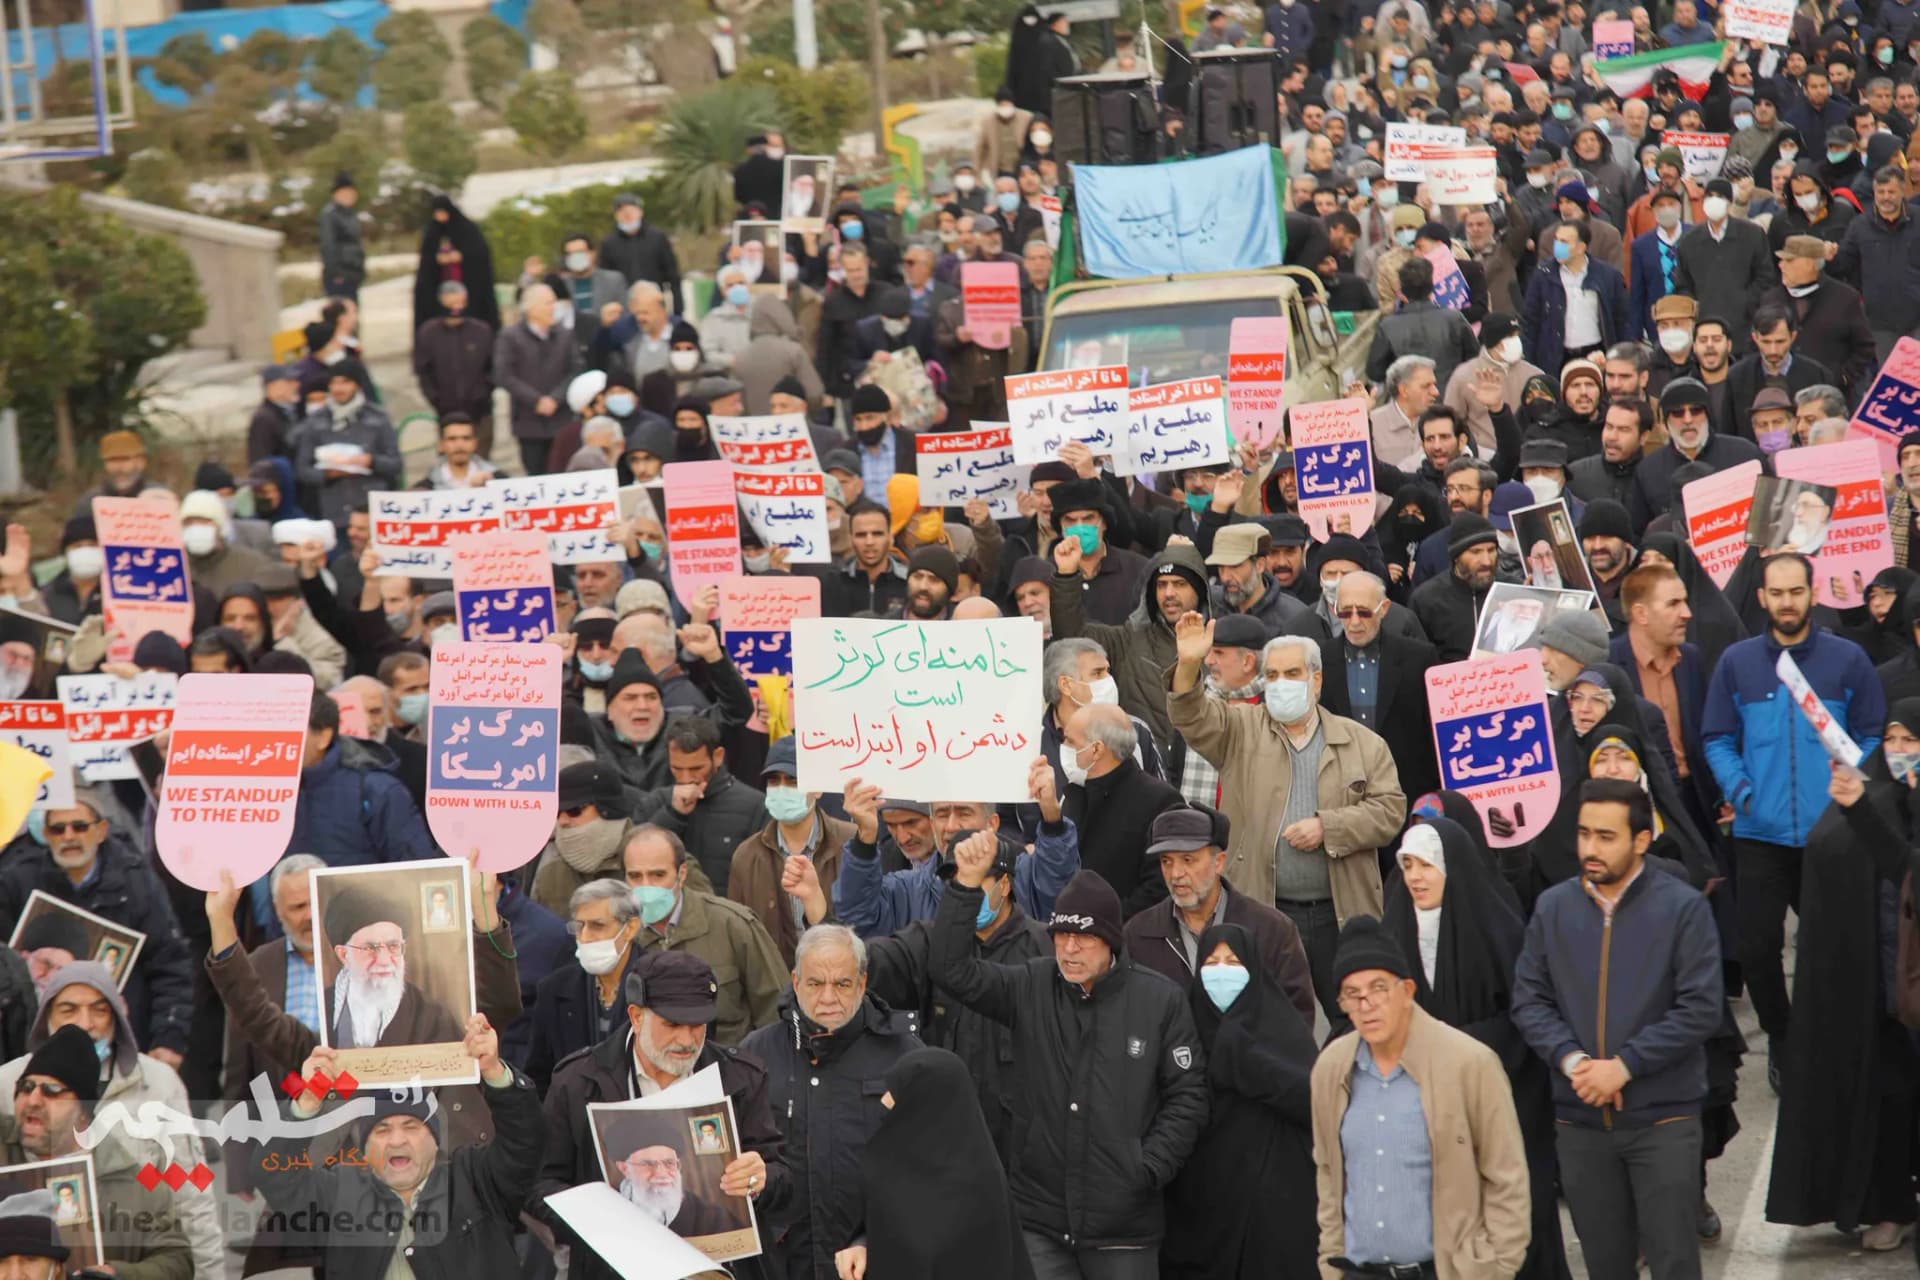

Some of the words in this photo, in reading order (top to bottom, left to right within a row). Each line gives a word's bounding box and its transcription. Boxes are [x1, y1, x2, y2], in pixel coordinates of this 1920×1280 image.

[1032, 374, 1073, 391] ایستاده
[1076, 369, 1098, 389] آخر
[1100, 370, 1109, 383] تا
[1110, 370, 1122, 383] ما
[1013, 382, 1031, 397] ایم
[1168, 382, 1190, 403] آخر
[1193, 383, 1202, 396] تا
[1203, 382, 1215, 394] ما
[1876, 385, 1899, 402] بر
[1025, 400, 1053, 428] امر
[1060, 394, 1119, 423] مطیع
[1232, 402, 1243, 411] TO
[1244, 402, 1258, 411] THE
[1260, 401, 1277, 410] END
[1154, 406, 1212, 436] مطیع
[923, 437, 940, 452] ایم
[942, 435, 981, 450] ایستاده
[984, 429, 1006, 449] آخر
[1140, 439, 1210, 466] رهبریم
[1303, 451, 1318, 472] بر
[1321, 444, 1361, 467] مرگ
[934, 456, 961, 479] امر
[967, 450, 1015, 477] طیع
[774, 476, 794, 496] آخر
[806, 477, 818, 491] ما
[1302, 468, 1365, 494] امریکا
[379, 498, 431, 520] آمریکا
[439, 505, 451, 519] بر
[459, 498, 494, 516] مرگ
[764, 501, 814, 527] مطیع
[377, 523, 439, 546] اسرائیل
[1827, 523, 1886, 541] TANDUP
[1717, 540, 1747, 557] STAN
[1851, 539, 1881, 553] END
[112, 551, 131, 572] بر
[132, 548, 178, 573] مرگ
[678, 564, 691, 575] TO
[693, 563, 710, 573] THE
[713, 561, 734, 572] END
[112, 573, 184, 601] امریکا
[468, 596, 489, 619] بر
[493, 590, 544, 616] مرگ
[468, 618, 549, 643] امریکا
[734, 637, 754, 658] بر
[804, 623, 908, 692] کوثر
[478, 653, 499, 668] مرگ
[502, 654, 523, 669] شعار
[524, 657, 547, 669] همین
[452, 671, 486, 685] اسرائیل
[499, 671, 520, 685] مرگ
[521, 675, 528, 685] و
[439, 686, 461, 701] آورد
[463, 690, 478, 701] می
[480, 688, 504, 701] مرگ
[504, 687, 520, 700] آنها
[522, 691, 544, 704] برای
[894, 680, 963, 707] است
[26, 706, 40, 723] تا
[41, 706, 58, 723] ما
[69, 712, 129, 740] اسرائیل
[443, 715, 471, 745] بر
[478, 709, 545, 747] مرگ
[802, 712, 861, 753] است
[1477, 711, 1536, 742] مرگ
[898, 719, 937, 770] او
[946, 712, 1028, 761] دشمن
[1449, 725, 1472, 753] بر
[171, 743, 196, 765] ایم
[197, 743, 250, 765] ایستاده
[250, 742, 285, 766] آخر
[285, 743, 299, 761] تا
[1449, 740, 1543, 781] امریکا
[440, 751, 546, 790] امریکا
[167, 787, 198, 802] WE
[201, 788, 294, 803] STANDUP
[1486, 785, 1515, 798] WITH
[1519, 780, 1546, 793] U.S.A
[429, 797, 470, 808] DOWN
[473, 798, 506, 809] WITH
[510, 799, 542, 810] U.S.A
[171, 807, 197, 822] TO
[199, 808, 237, 822] THE
[239, 808, 281, 823] END
